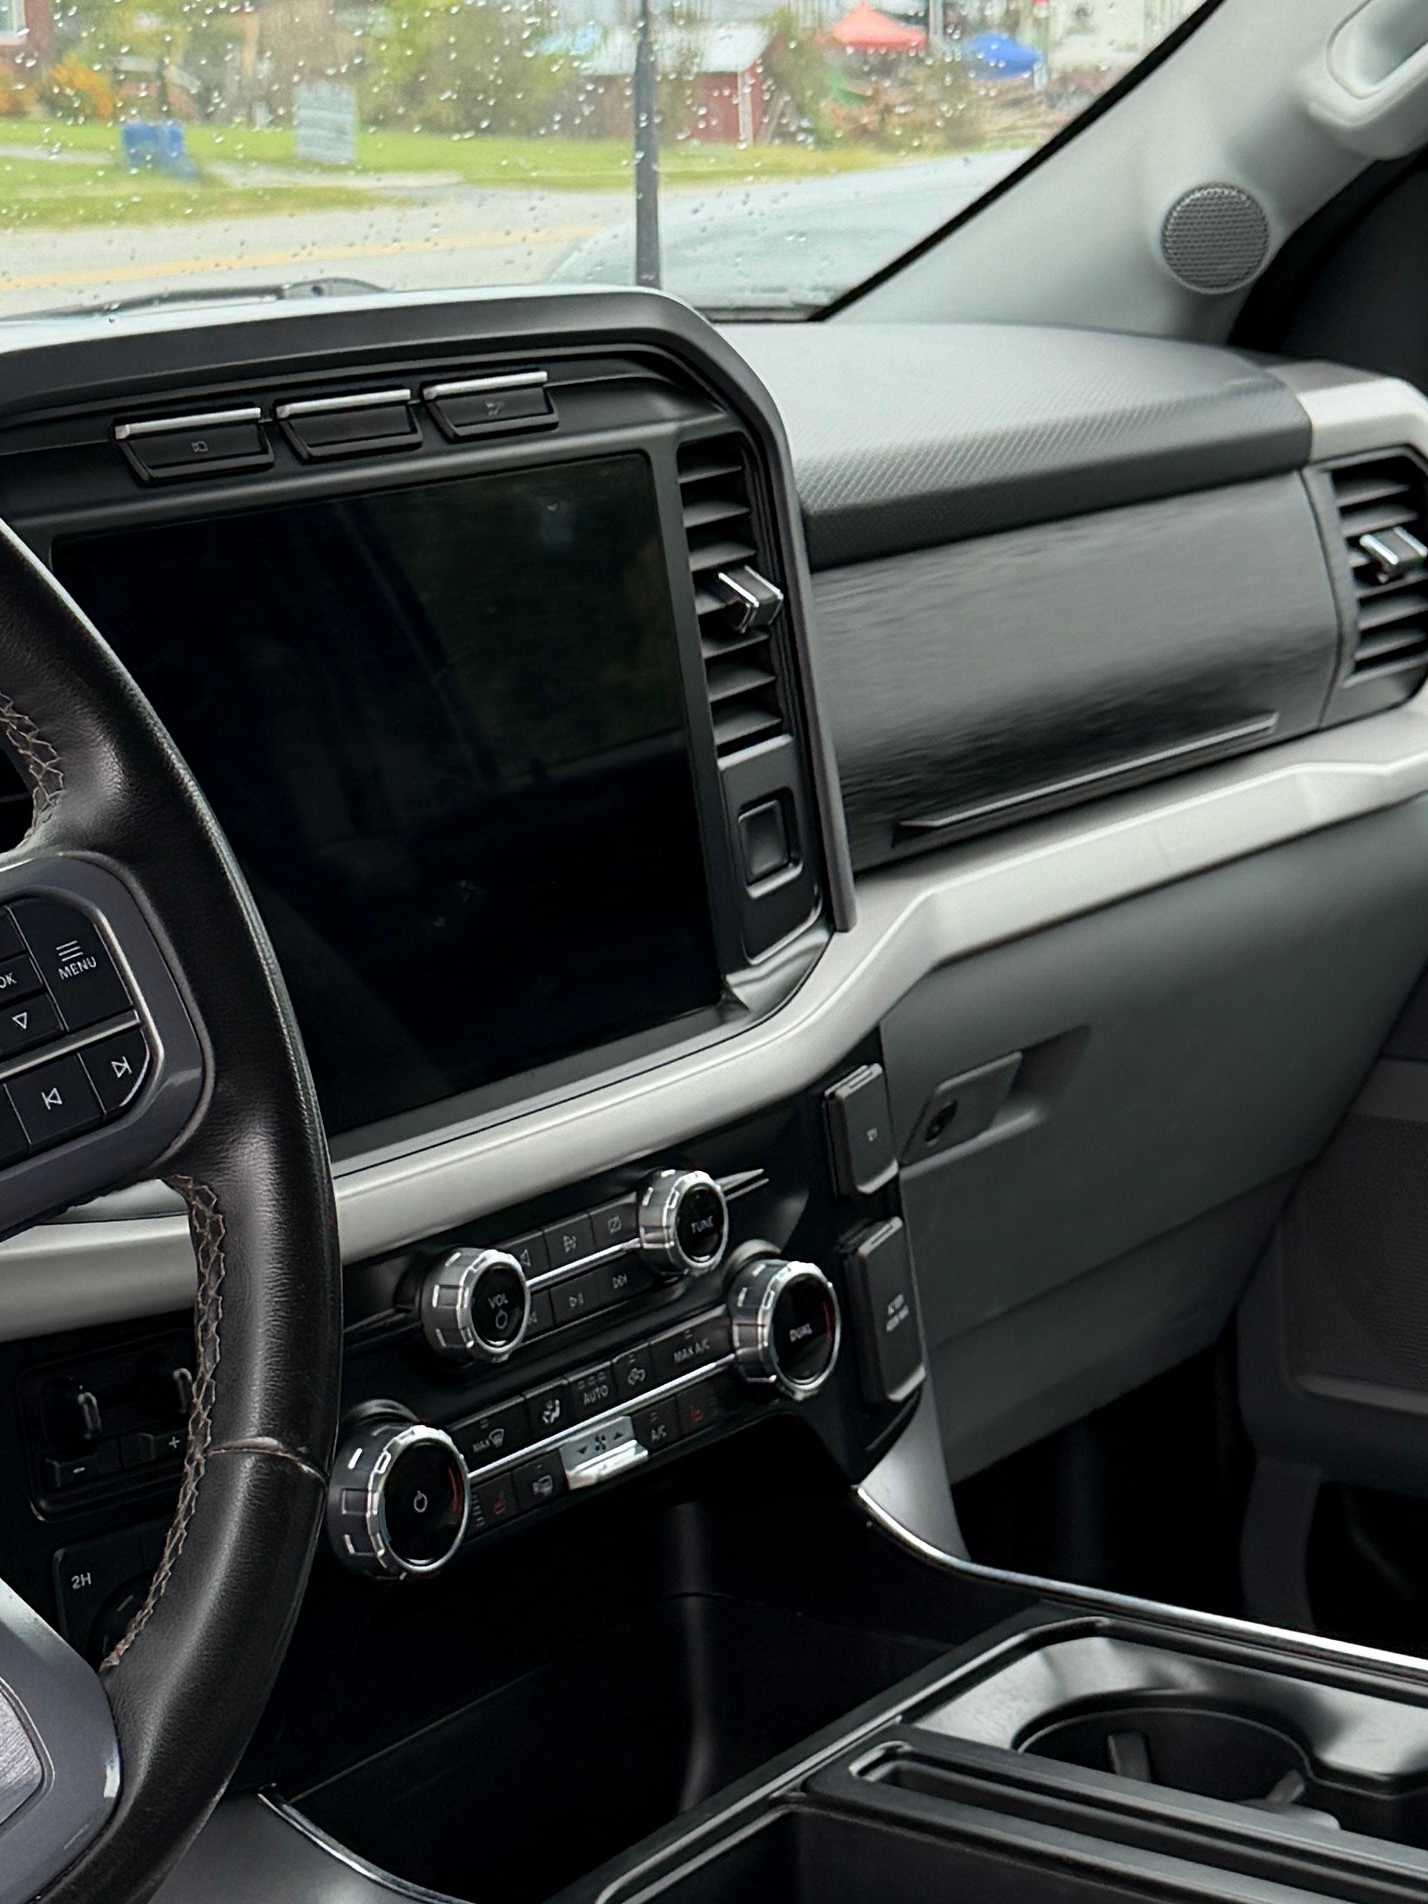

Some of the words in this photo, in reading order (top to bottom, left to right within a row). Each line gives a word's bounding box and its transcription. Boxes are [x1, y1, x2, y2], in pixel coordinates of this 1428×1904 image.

[58, 955, 97, 980] MENU
[691, 1214, 714, 1235] TUNE
[487, 1293, 509, 1310] VOL
[673, 1345, 694, 1363] MAX
[583, 1384, 609, 1406] AUTO
[71, 1571, 92, 1590] 2H
